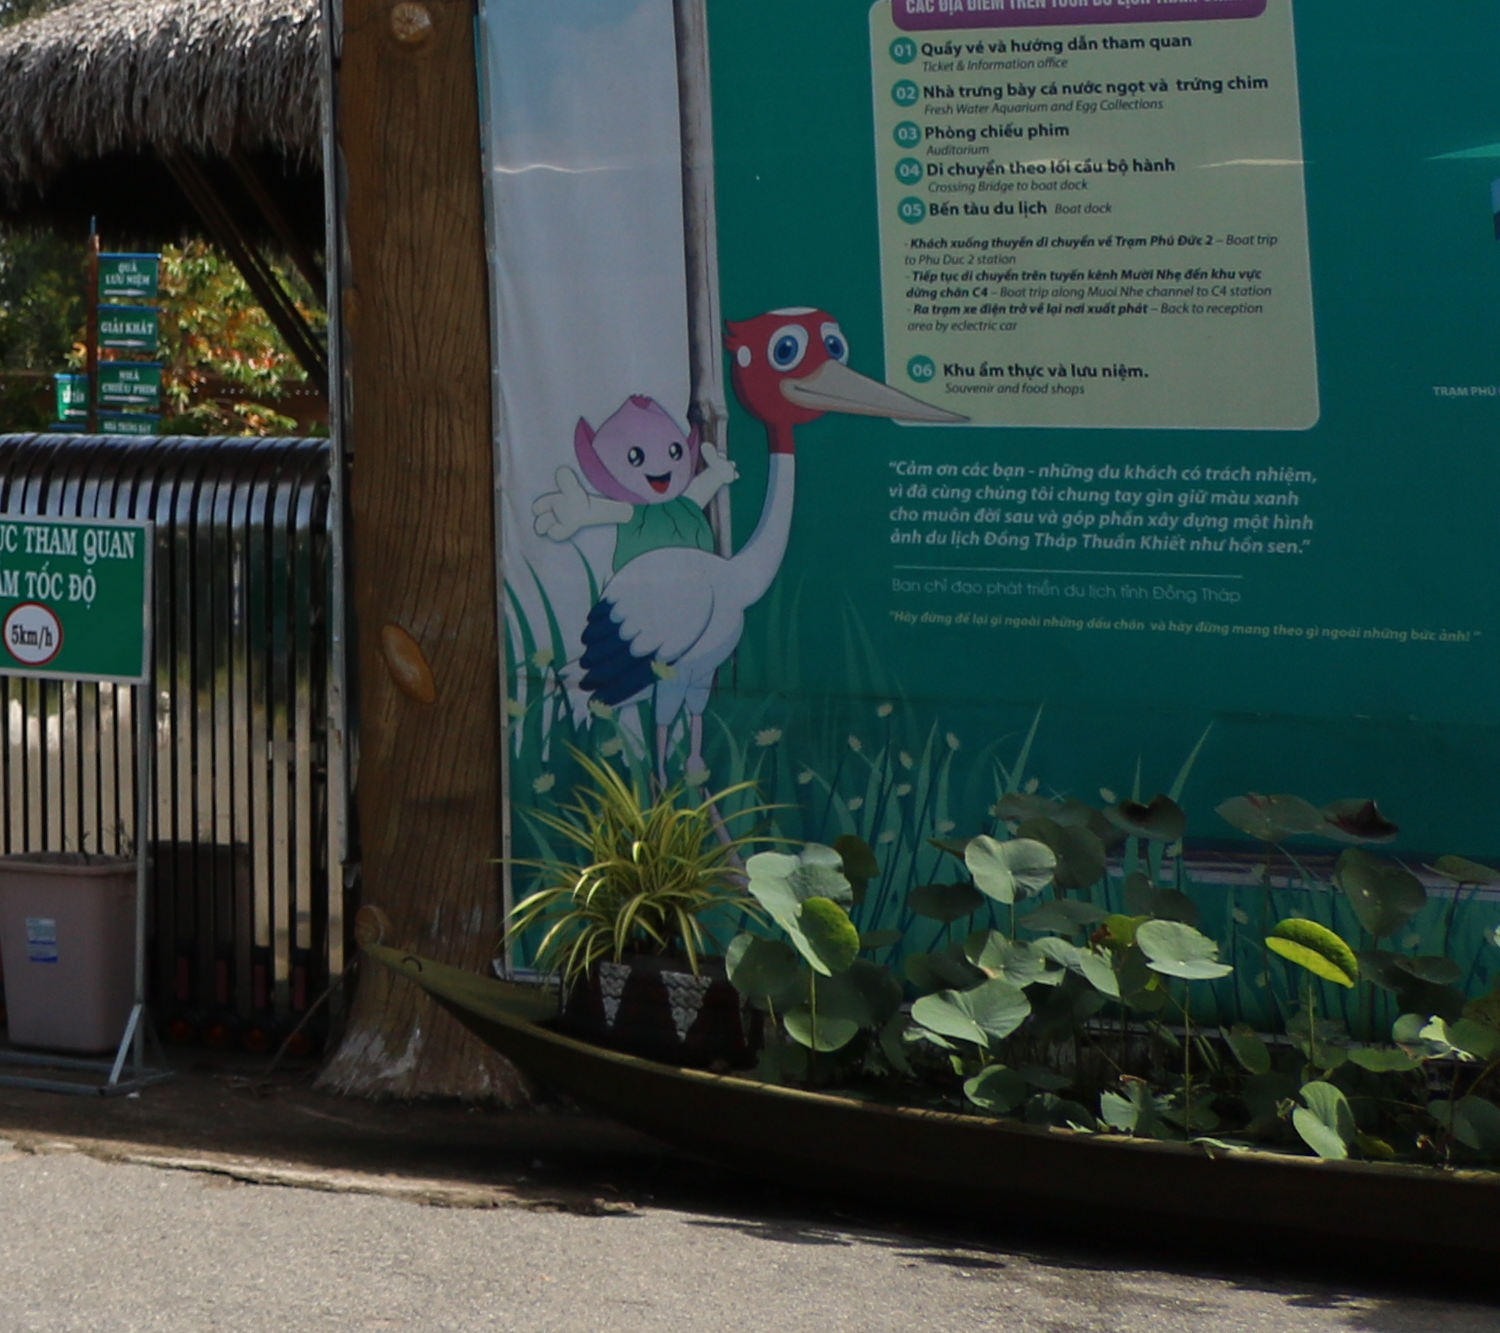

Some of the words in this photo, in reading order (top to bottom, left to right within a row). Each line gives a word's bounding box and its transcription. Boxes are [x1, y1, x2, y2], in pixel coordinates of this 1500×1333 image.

[894, 44, 912, 57] 01
[965, 39, 984, 53] vé
[987, 39, 1006, 53] và
[1010, 38, 1063, 54] hướng
[1067, 35, 1097, 50] dẫn
[1101, 35, 1145, 49] tham
[1149, 36, 1191, 51] quan
[922, 60, 953, 72] Ticket
[956, 59, 964, 71] &
[967, 58, 1034, 70] Information
[1036, 56, 1068, 68] office
[896, 86, 915, 100] 02
[923, 84, 954, 98] Nhà
[958, 85, 1002, 100] trưng
[1006, 82, 1036, 99] bày
[1040, 81, 1057, 95] cá
[1061, 81, 1102, 95] nước
[1106, 80, 1145, 96] ngọt
[1148, 78, 1168, 92] và
[1175, 77, 1222, 93] trứng
[1227, 75, 1268, 89] chim
[924, 103, 953, 115] Fresh
[956, 103, 989, 114] Water
[991, 101, 1048, 115] Aquarium
[1050, 99, 1073, 112] and
[1075, 99, 1097, 114] Egg
[1099, 98, 1163, 110] Collections
[898, 127, 917, 141] 03
[924, 125, 976, 141] Phòng
[1027, 122, 1069, 140] phim
[926, 144, 989, 155] Auditorium
[913, 364, 933, 377] 06
[943, 362, 974, 376] Khu
[1007, 362, 1043, 380] thực
[1047, 363, 1067, 377] và
[1070, 363, 1097, 377] lưu
[944, 382, 994, 394] Souvenir
[996, 382, 1019, 393] and
[1021, 382, 1048, 394] food
[1050, 382, 1084, 396] shops
[23, 526, 79, 556] THAM
[83, 528, 137, 566] QUAN
[24, 561, 64, 601] TỐC
[68, 568, 97, 610] ĐỘ
[11, 624, 54, 651] 5km/h
